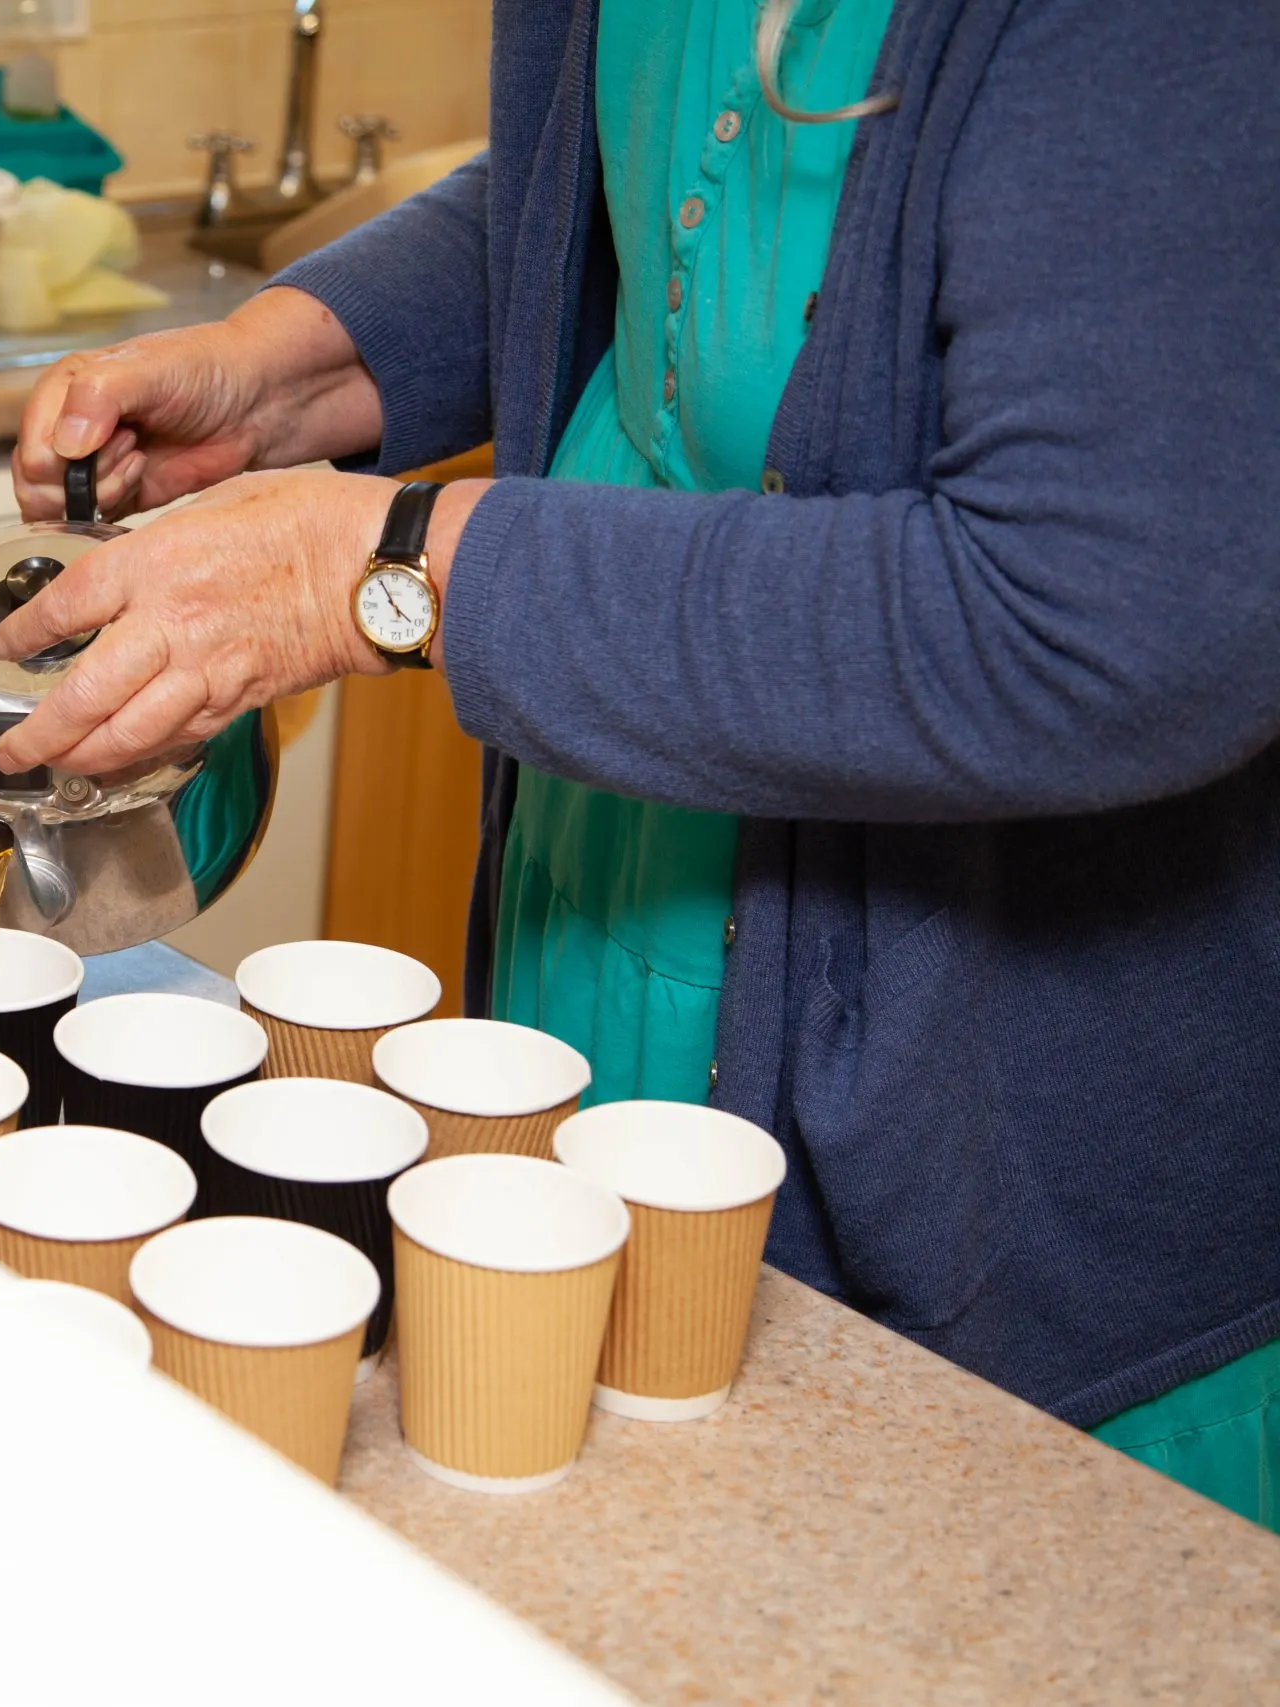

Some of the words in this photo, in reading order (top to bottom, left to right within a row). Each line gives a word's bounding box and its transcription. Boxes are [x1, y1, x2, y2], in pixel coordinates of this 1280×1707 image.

[414, 618, 425, 628] 10
[390, 631, 402, 641] 12
[406, 628, 415, 638] 11
